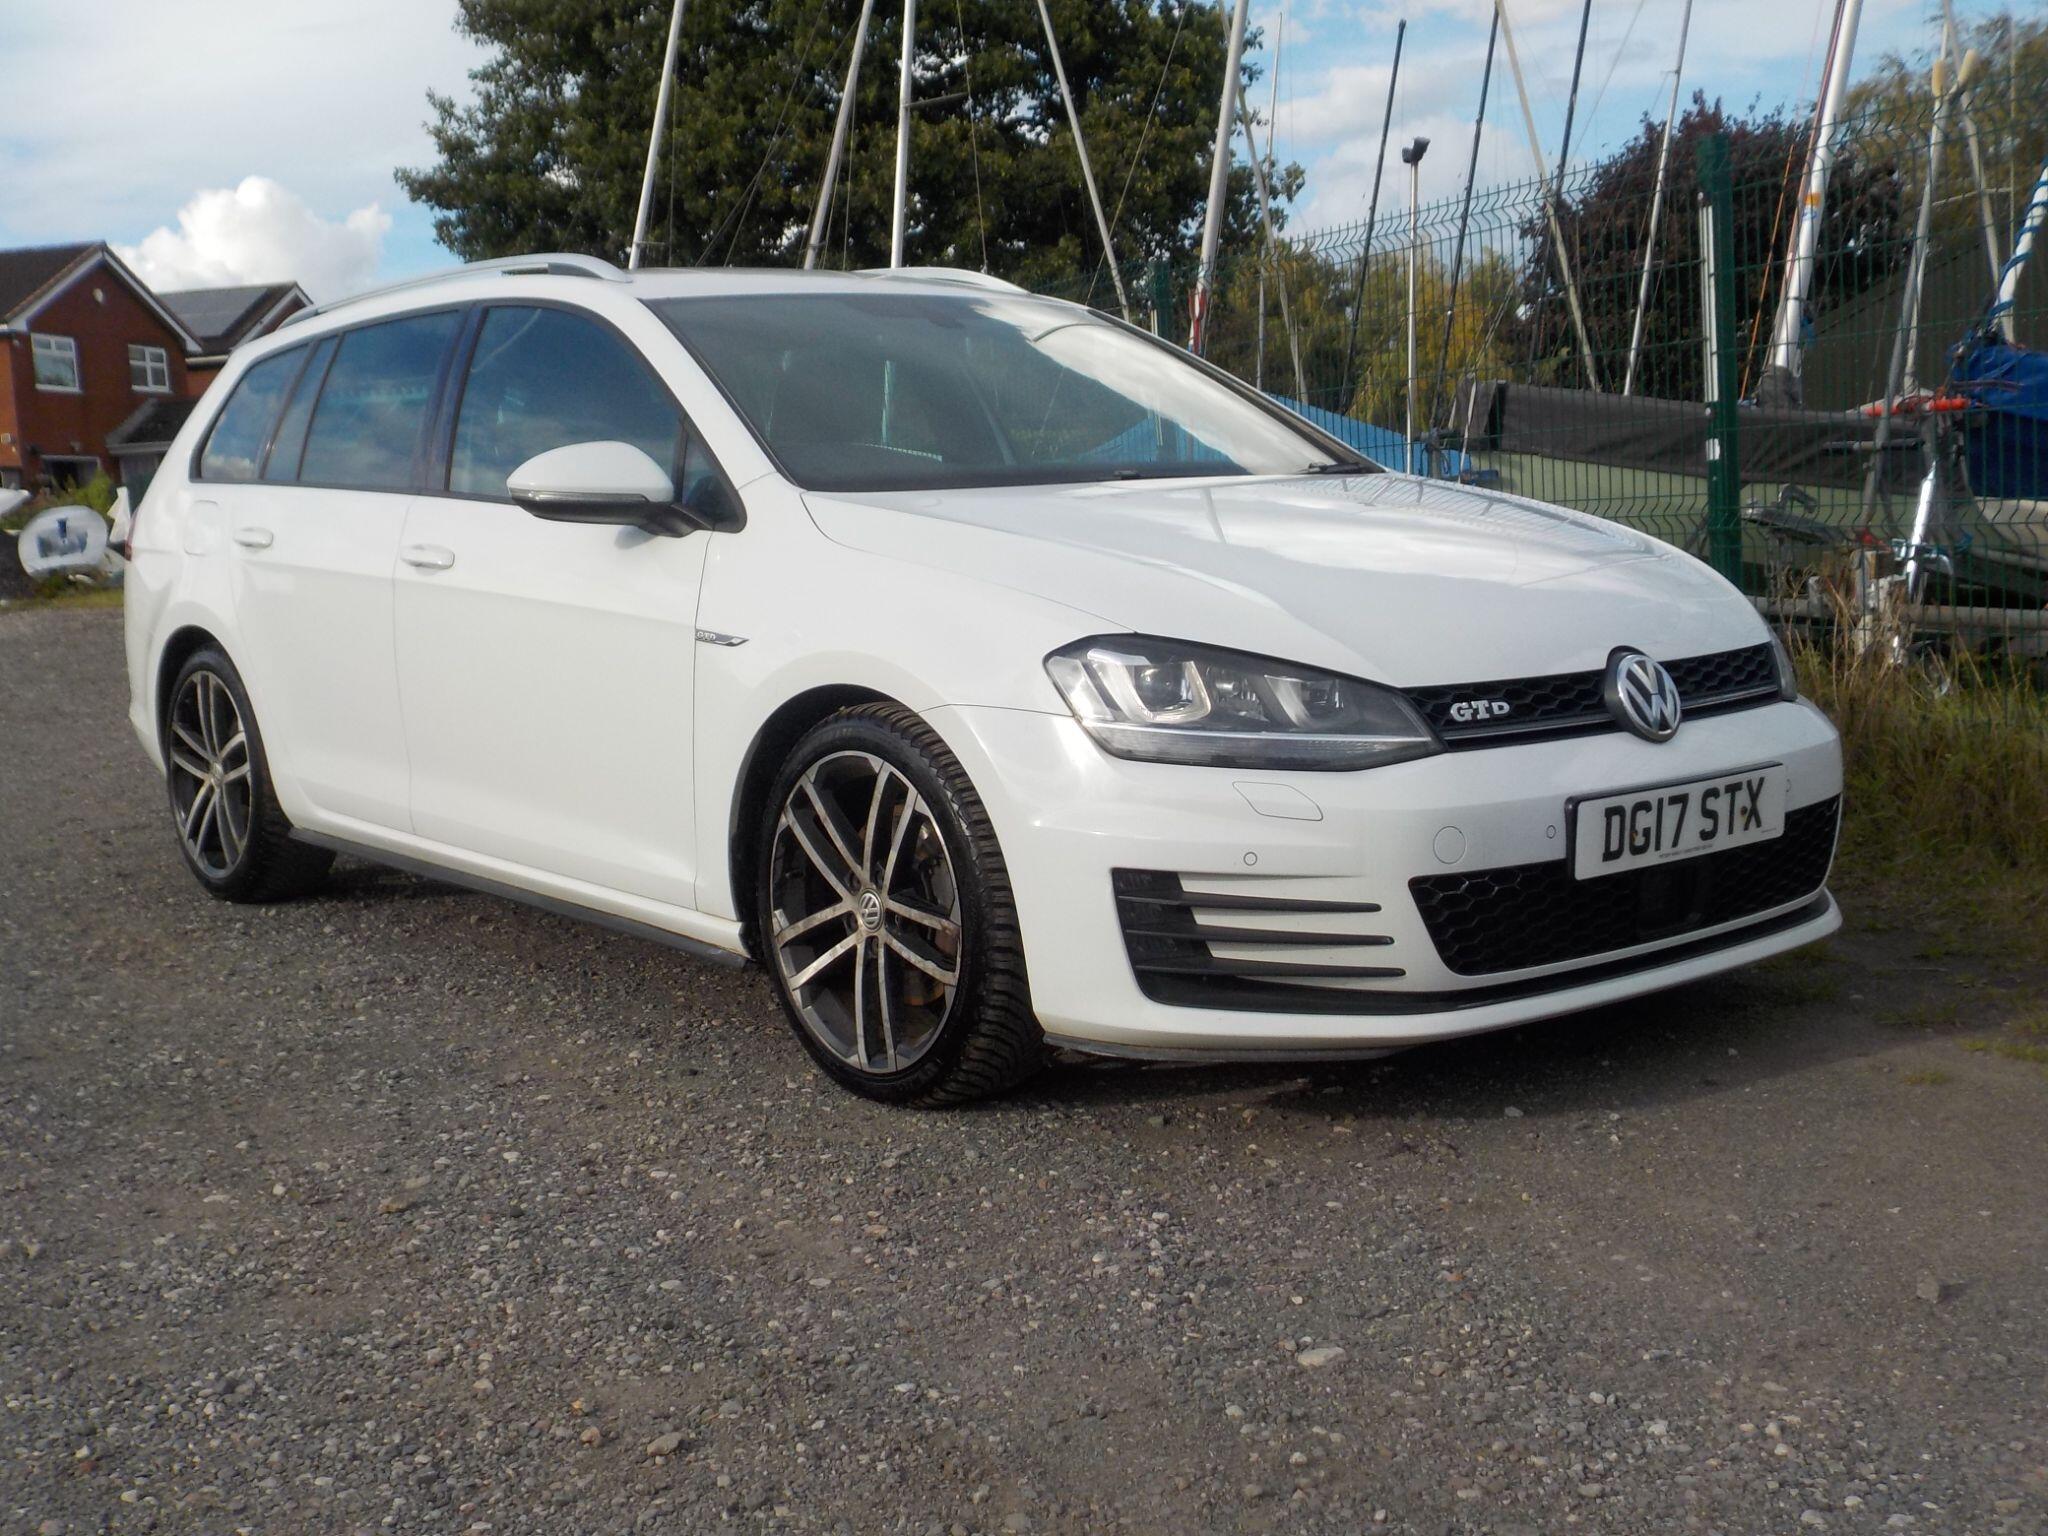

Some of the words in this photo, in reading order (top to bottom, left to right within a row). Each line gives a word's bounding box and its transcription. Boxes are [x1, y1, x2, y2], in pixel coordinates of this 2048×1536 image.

[1450, 699, 1510, 722] GTD
[1602, 793, 1690, 862] DG17
[1699, 777, 1765, 841] STX
